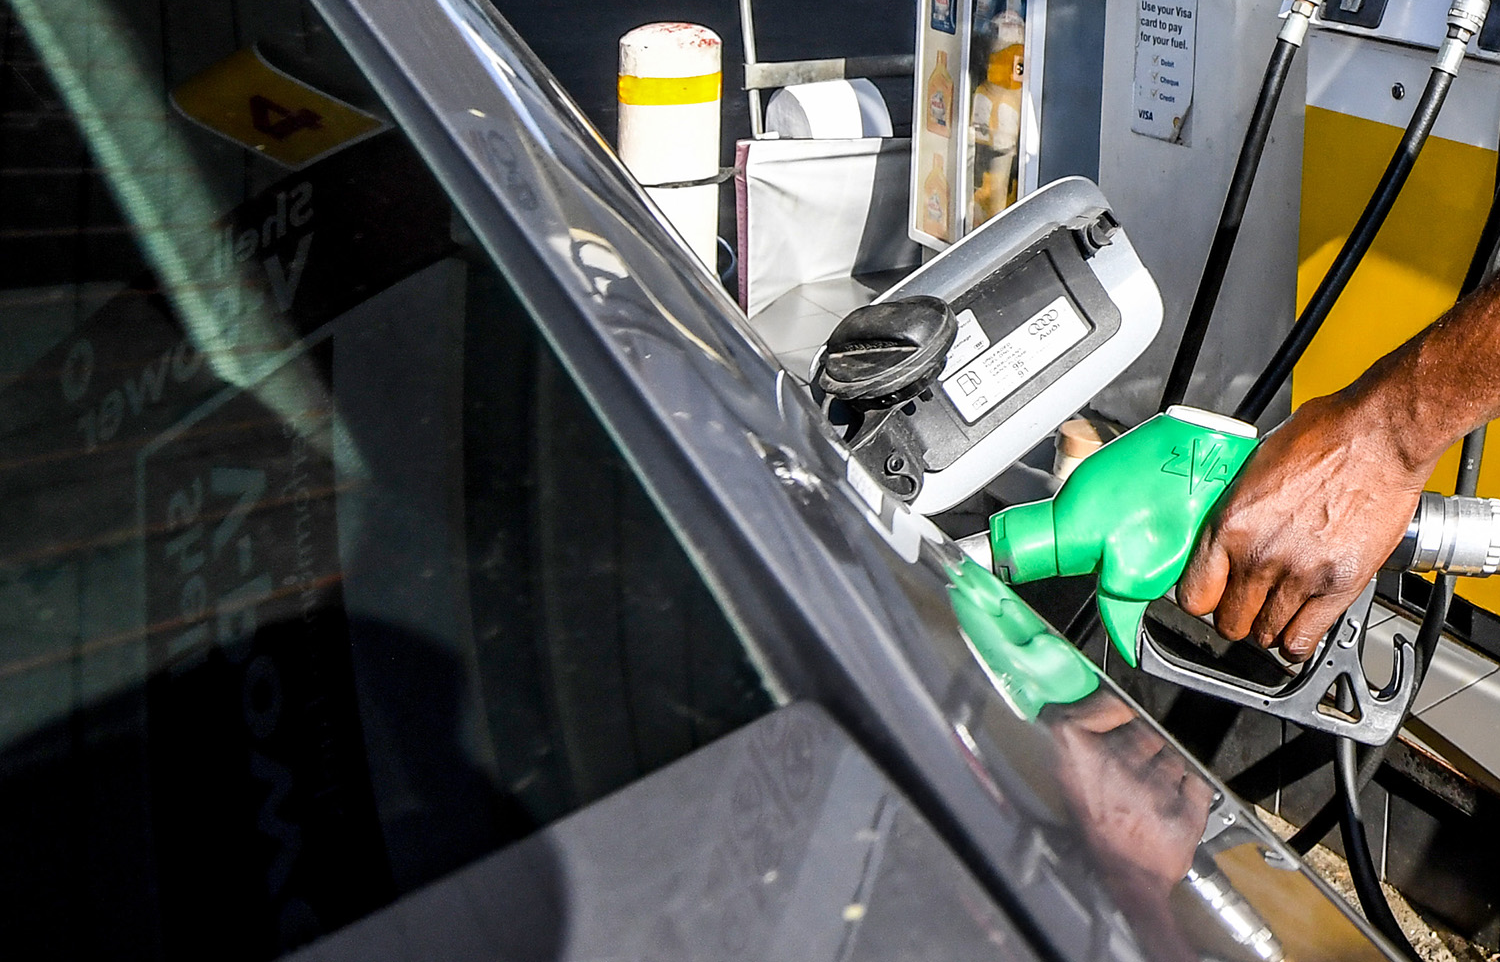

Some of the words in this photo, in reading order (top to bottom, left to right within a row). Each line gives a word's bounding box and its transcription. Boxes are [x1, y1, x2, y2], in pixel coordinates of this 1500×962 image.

[1141, 0, 1156, 13] Use
[1157, 4, 1175, 17] your
[1175, 5, 1192, 19] Visa
[1140, 17, 1158, 30] card
[1158, 19, 1167, 30] to
[1167, 22, 1183, 36] pay
[1140, 30, 1151, 42] for
[1152, 35, 1171, 48] your
[1170, 37, 1189, 51] fuel.
[1160, 58, 1175, 69] Debit
[1159, 76, 1180, 88] Cheque
[1159, 93, 1176, 104] Credit
[1138, 109, 1154, 122] VISA
[1039, 323, 1061, 341] Audi
[1012, 360, 1025, 371] 95
[1017, 367, 1029, 378] 91
